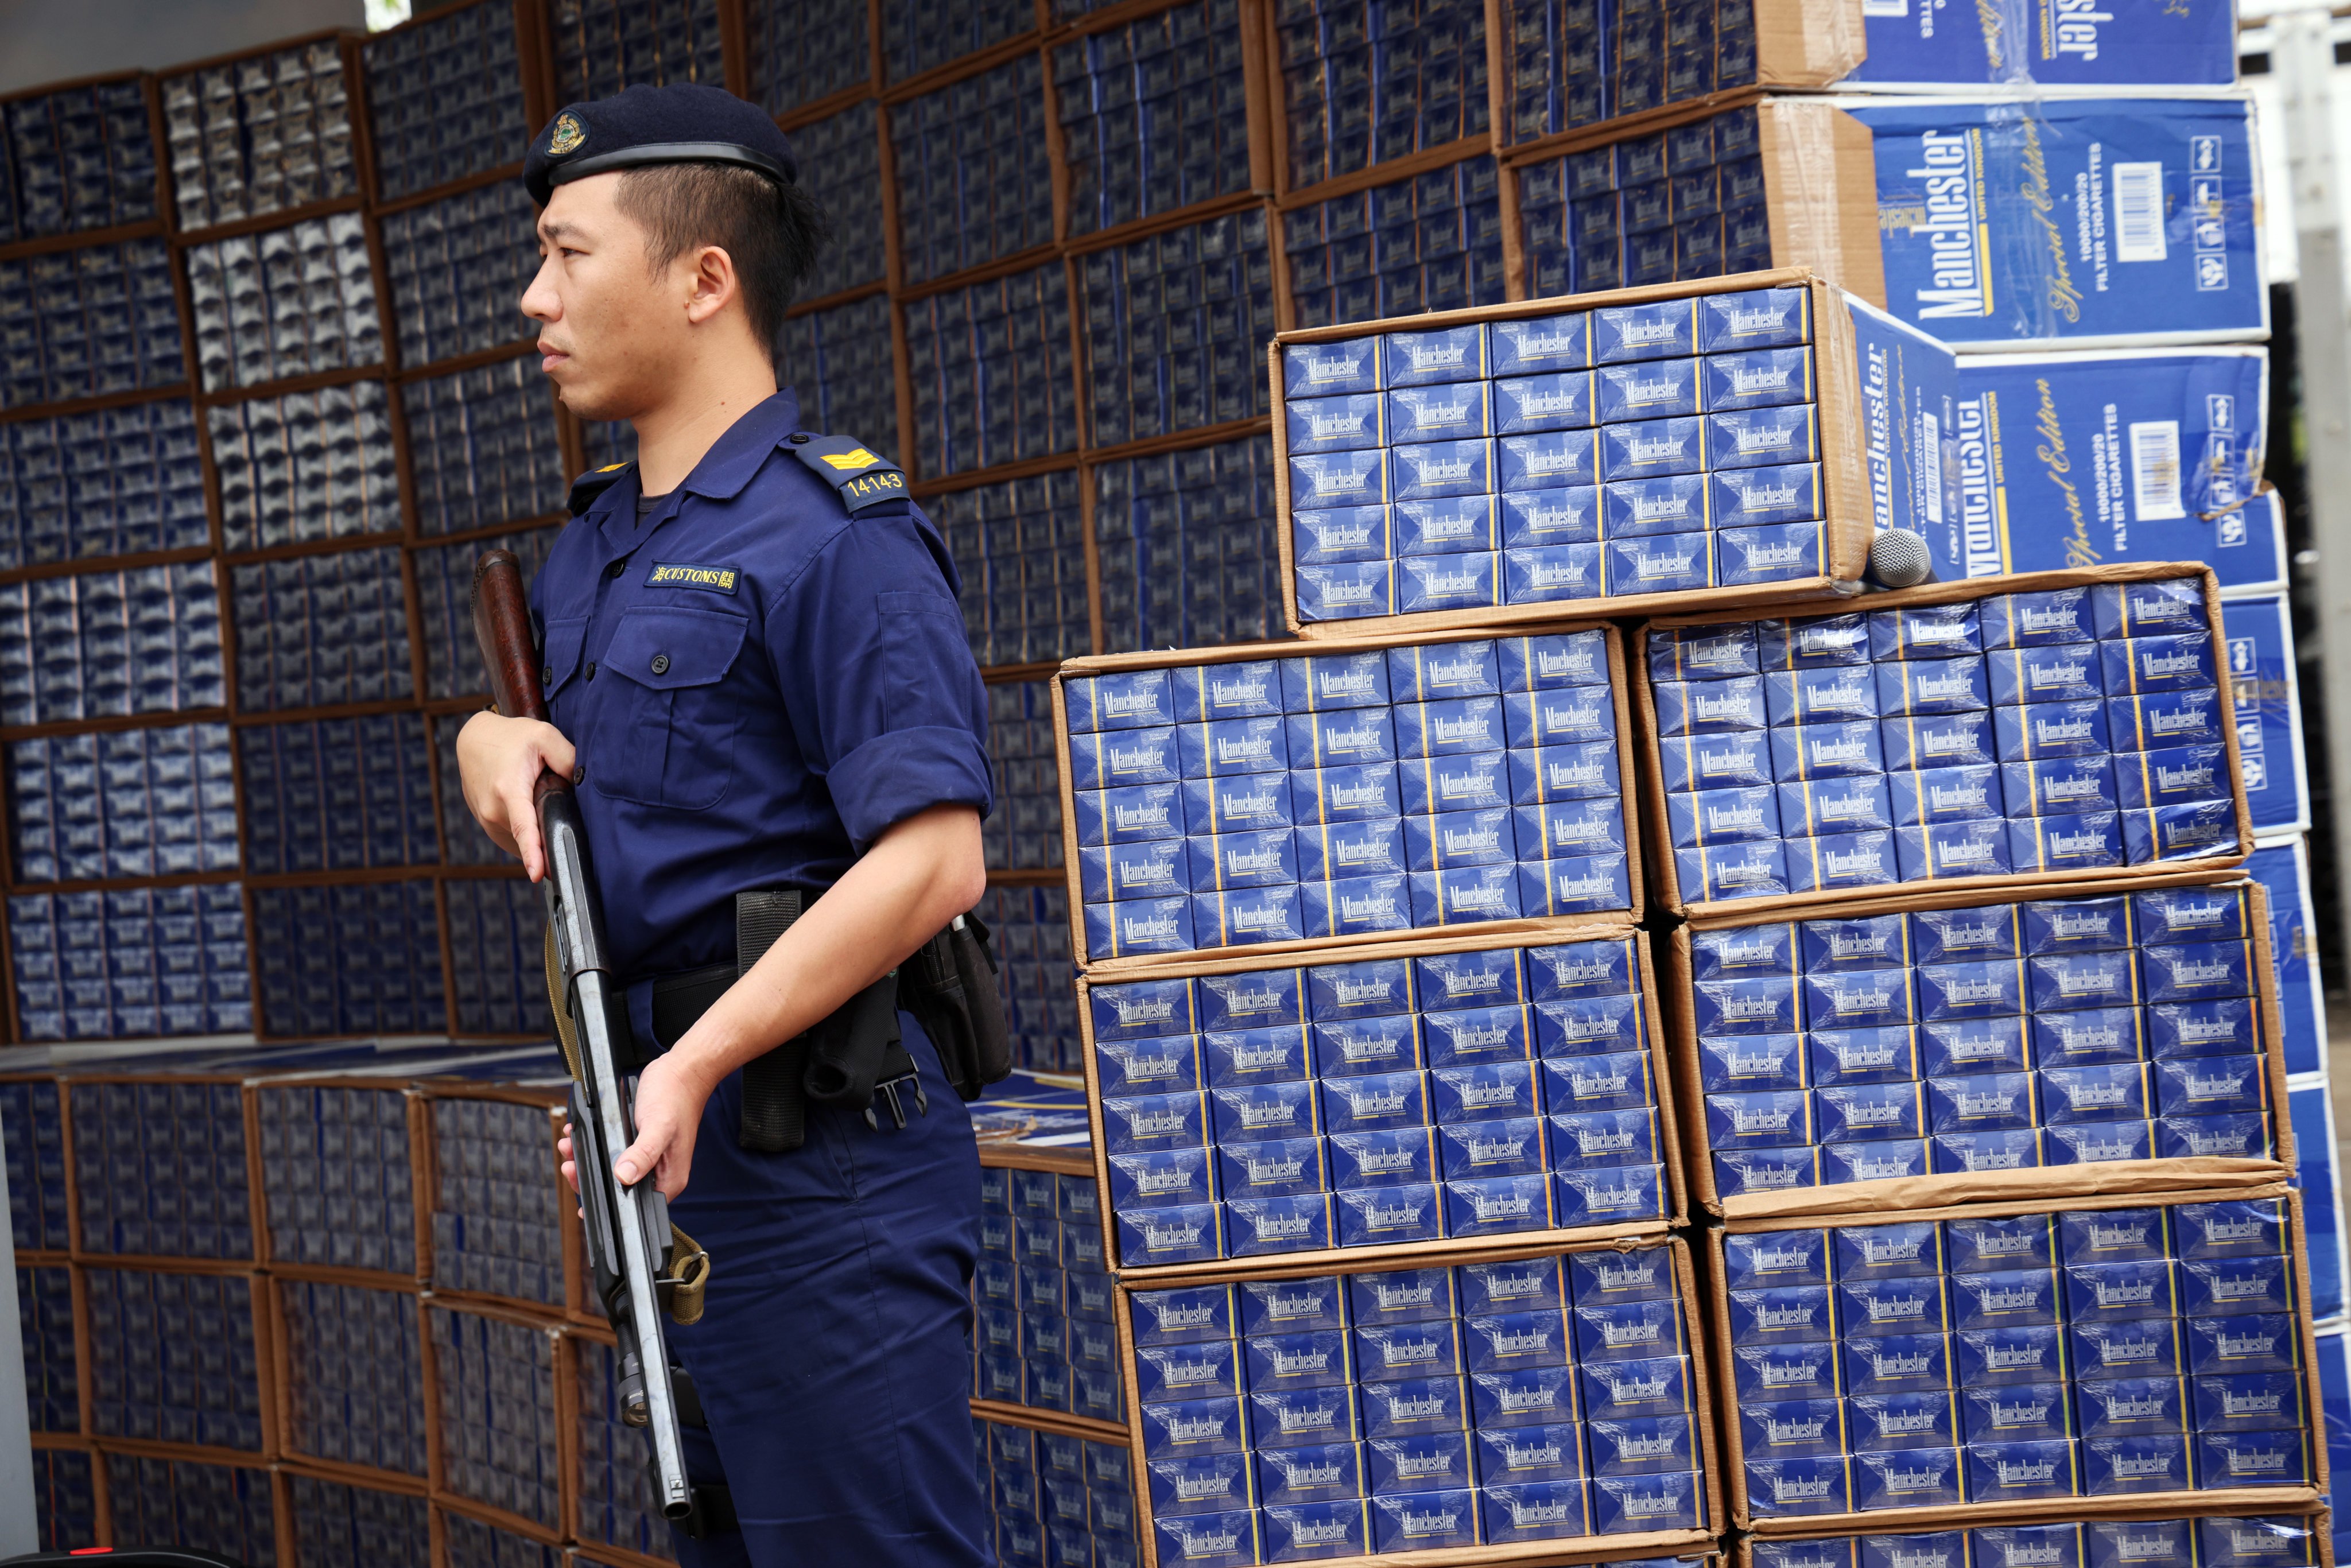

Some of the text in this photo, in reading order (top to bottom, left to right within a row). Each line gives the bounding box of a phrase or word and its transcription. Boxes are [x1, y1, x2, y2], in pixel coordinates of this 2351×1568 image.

[1971, 128, 1987, 220] UNITED KINGDOM
[1906, 130, 1984, 320] Manchester
[2020, 117, 2084, 323] Special Edition
[2088, 142, 2109, 292] FILTER CIGARETTES
[1623, 317, 1676, 344] Manchester
[1731, 306, 1784, 333] Manchester
[1413, 343, 1463, 368] Manchester
[1518, 331, 1571, 358] Manchester
[1309, 355, 1359, 381] Manchester
[1735, 366, 1788, 393] Manchester
[1626, 377, 1679, 403] Manchester
[1417, 401, 1467, 426] Manchester
[2035, 378, 2071, 473] Edition
[1738, 424, 1791, 451] Manchester
[1987, 390, 2005, 483] UNITED KINGDOM
[1526, 447, 1579, 474] Manchester
[848, 473, 902, 497] 14143
[2091, 433, 2111, 523] 10000/200/20
[2102, 402, 2128, 552] FILTER CIGARETTES
[1634, 493, 1687, 520] Manchester
[1743, 483, 1796, 510] Manchester
[1423, 514, 1473, 540] Manchester
[1748, 541, 1801, 568] Manchester
[652, 566, 735, 589] 海 CUSTOMS 關
[1531, 560, 1585, 587] Manchester
[2134, 592, 2192, 620] Manchester
[1538, 649, 1593, 673] Manchester
[1687, 639, 1744, 664] Manchester
[1320, 669, 1374, 694] Manchester
[1429, 659, 1484, 684] Manchester
[2030, 661, 2086, 686] Manchester
[1212, 679, 1267, 704] Manchester
[1806, 683, 1863, 708] Manchester
[1917, 673, 1973, 698] Manchester
[1104, 689, 1158, 714] Manchester
[1695, 693, 1752, 719] Manchester
[1434, 715, 1489, 740] Manchester
[1545, 704, 1600, 729] Manchester
[1326, 726, 1380, 751] Manchester
[2036, 717, 2093, 743] Manchester
[1110, 746, 1165, 771] Manchester
[1217, 735, 1272, 760] Manchester
[1700, 748, 1756, 773] Manchester
[1440, 771, 1495, 795] Manchester
[2044, 774, 2101, 799] Manchester
[1223, 791, 1277, 816] Manchester
[1819, 793, 1876, 818] Manchester
[1445, 827, 1499, 852] Manchester
[1554, 817, 1609, 841] Manchester
[1227, 848, 1282, 872] Manchester
[1938, 839, 1995, 864] Manchester
[1120, 859, 1174, 883] Manchester
[1717, 858, 1771, 884] Manchester
[1341, 894, 1395, 918] Manchester
[2167, 901, 2224, 928] Manchester
[1124, 915, 1178, 940] Manchester
[1941, 922, 1998, 949] Manchester
[1721, 940, 1774, 965] Manchester
[1446, 969, 1500, 994] Manchester
[2059, 968, 2116, 995] Manchester
[1117, 998, 1172, 1023] Manchester
[1227, 988, 1281, 1014] Manchester
[1834, 987, 1891, 1014] Manchester
[1565, 1015, 1619, 1041] Manchester
[2063, 1025, 2120, 1052] Manchester
[1233, 1045, 1287, 1070] Manchester
[1343, 1035, 1397, 1060] Manchester
[1838, 1044, 1895, 1071] Manchester
[1124, 1055, 1178, 1080] Manchester
[1351, 1091, 1405, 1116] Manchester
[1461, 1081, 1515, 1107] Manchester
[2070, 1082, 2127, 1109] Manchester
[1130, 1111, 1185, 1136] Manchester
[1735, 1109, 1789, 1134] Manchester
[1469, 1138, 1523, 1163] Manchester
[1247, 1157, 1302, 1182] Manchester
[1586, 1185, 1640, 1210] Manchester
[1145, 1224, 1200, 1248] Manchester
[1255, 1213, 1310, 1238] Manchester
[2090, 1222, 2147, 1249] Manchester
[2203, 1217, 2263, 1243] Manchester
[1753, 1246, 1810, 1273] Manchester
[1863, 1237, 1921, 1264] Manchester
[1600, 1264, 1654, 1289] Manchester
[1377, 1283, 1432, 1307] Manchester
[2097, 1279, 2154, 1306] Manchester
[1157, 1303, 1212, 1328] Manchester
[1268, 1293, 1322, 1318] Manchester
[1868, 1297, 1925, 1320] Manchester
[1383, 1339, 1437, 1364] Manchester
[1493, 1329, 1547, 1354] Manchester
[1274, 1349, 1328, 1375] Manchester
[1986, 1344, 2043, 1371] Manchester
[1162, 1360, 1217, 1384] Manchester
[1500, 1386, 1554, 1411] Manchester
[1169, 1416, 1223, 1442] Manchester
[1879, 1408, 1935, 1435] Manchester
[1396, 1451, 1450, 1476] Manchester
[1175, 1473, 1230, 1498] Manchester
[1774, 1475, 1830, 1502] Manchester
[1621, 1493, 1679, 1516] Manchester
[1293, 1520, 1347, 1545] Manchester
[1402, 1510, 1456, 1535] Manchester
[2117, 1534, 2174, 1559] Manchester
[2230, 1530, 2290, 1553] Manchester
